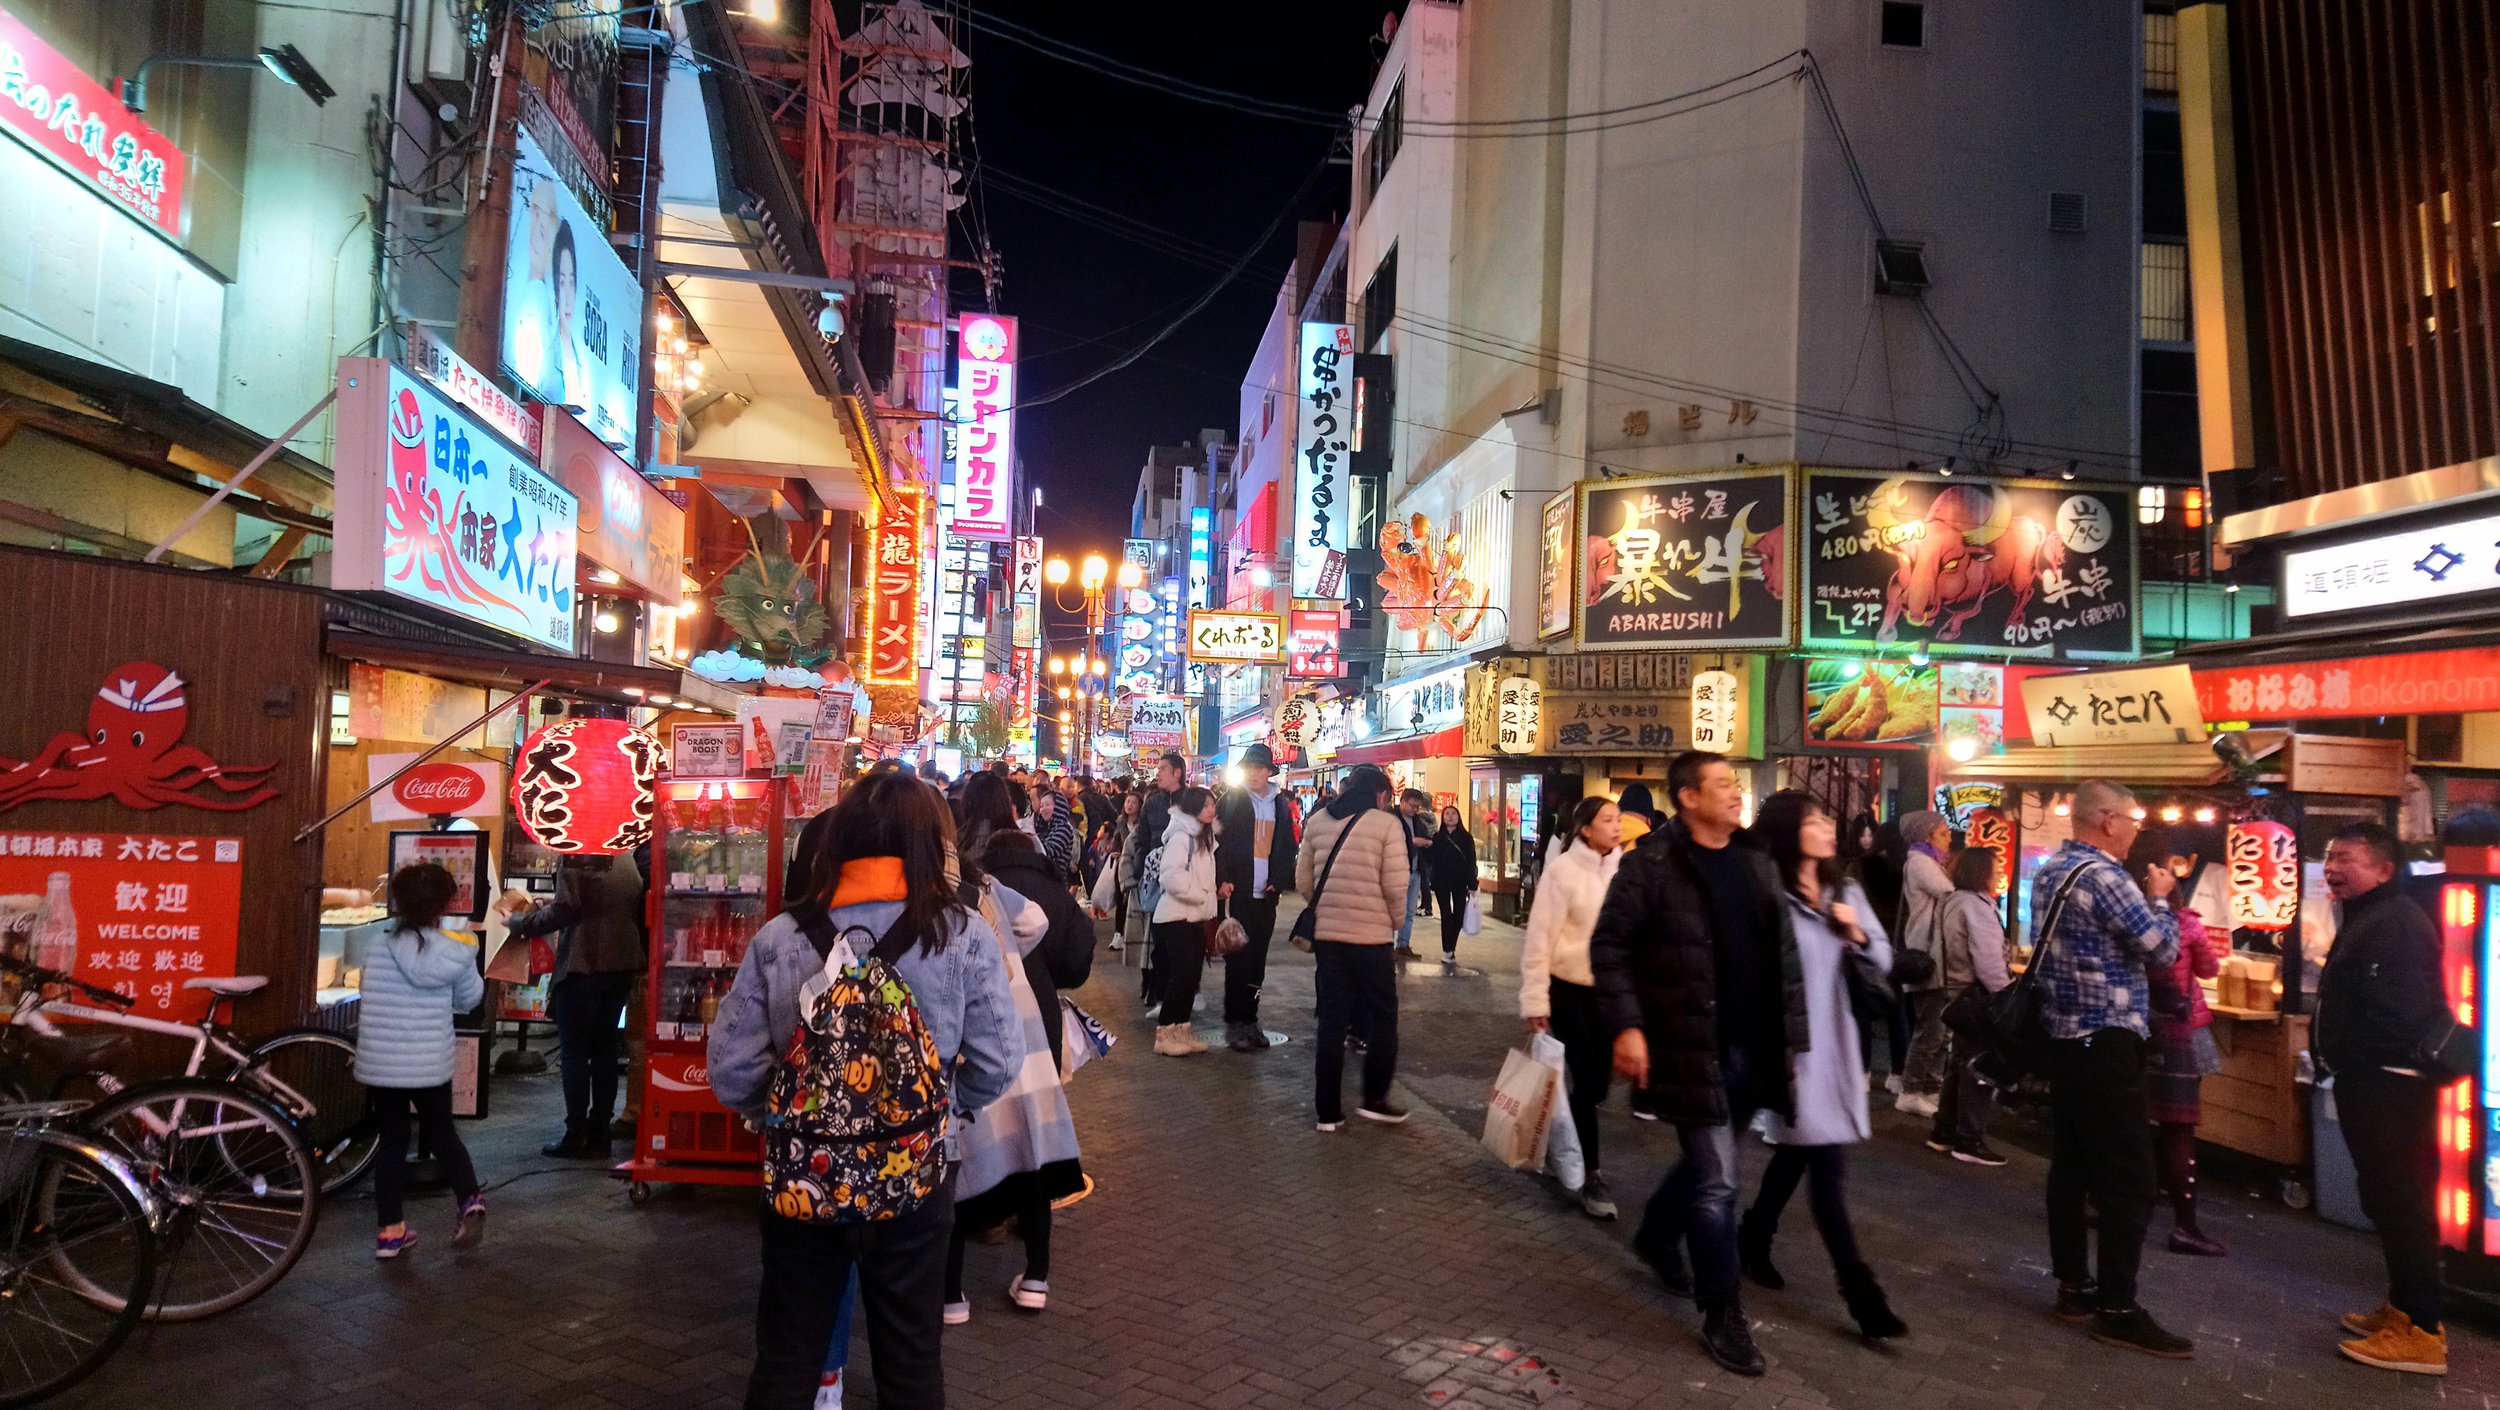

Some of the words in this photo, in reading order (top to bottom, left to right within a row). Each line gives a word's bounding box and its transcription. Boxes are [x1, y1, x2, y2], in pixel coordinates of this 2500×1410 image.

[583, 300, 608, 366] SORA
[434, 413, 489, 485] 日本一
[966, 367, 1001, 518] ジャンカラ
[1305, 343, 1347, 549] 串かつだるま
[508, 463, 568, 521] 創業昭和47年
[1639, 489, 1729, 525] 牛串屋
[1815, 486, 1908, 534] 生ビール
[2069, 500, 2104, 544] 炭
[460, 501, 497, 572] 本家
[498, 496, 570, 613] 大たこ
[1598, 527, 1766, 623] 暴れ牛
[2042, 557, 2114, 609] 牛串
[2303, 559, 2390, 594] 道頓堀
[1608, 610, 1725, 633] ABAREUSHI
[1851, 602, 1883, 627] 2F
[1198, 624, 1274, 649] くれおーる
[1573, 701, 1659, 719] 炭火やきとり
[2088, 690, 2172, 726] たこ八
[2226, 668, 2350, 713] お好み焼
[1133, 705, 1183, 726] わなか
[1501, 689, 1520, 744] 愛之助
[1695, 685, 1714, 743] 愛之助
[1558, 721, 1675, 748] 愛之助
[403, 776, 475, 800] Coca-Cola
[117, 837, 199, 861] 大たこ
[98, 924, 201, 940] WELCOME
[88, 951, 142, 972] 欢迎
